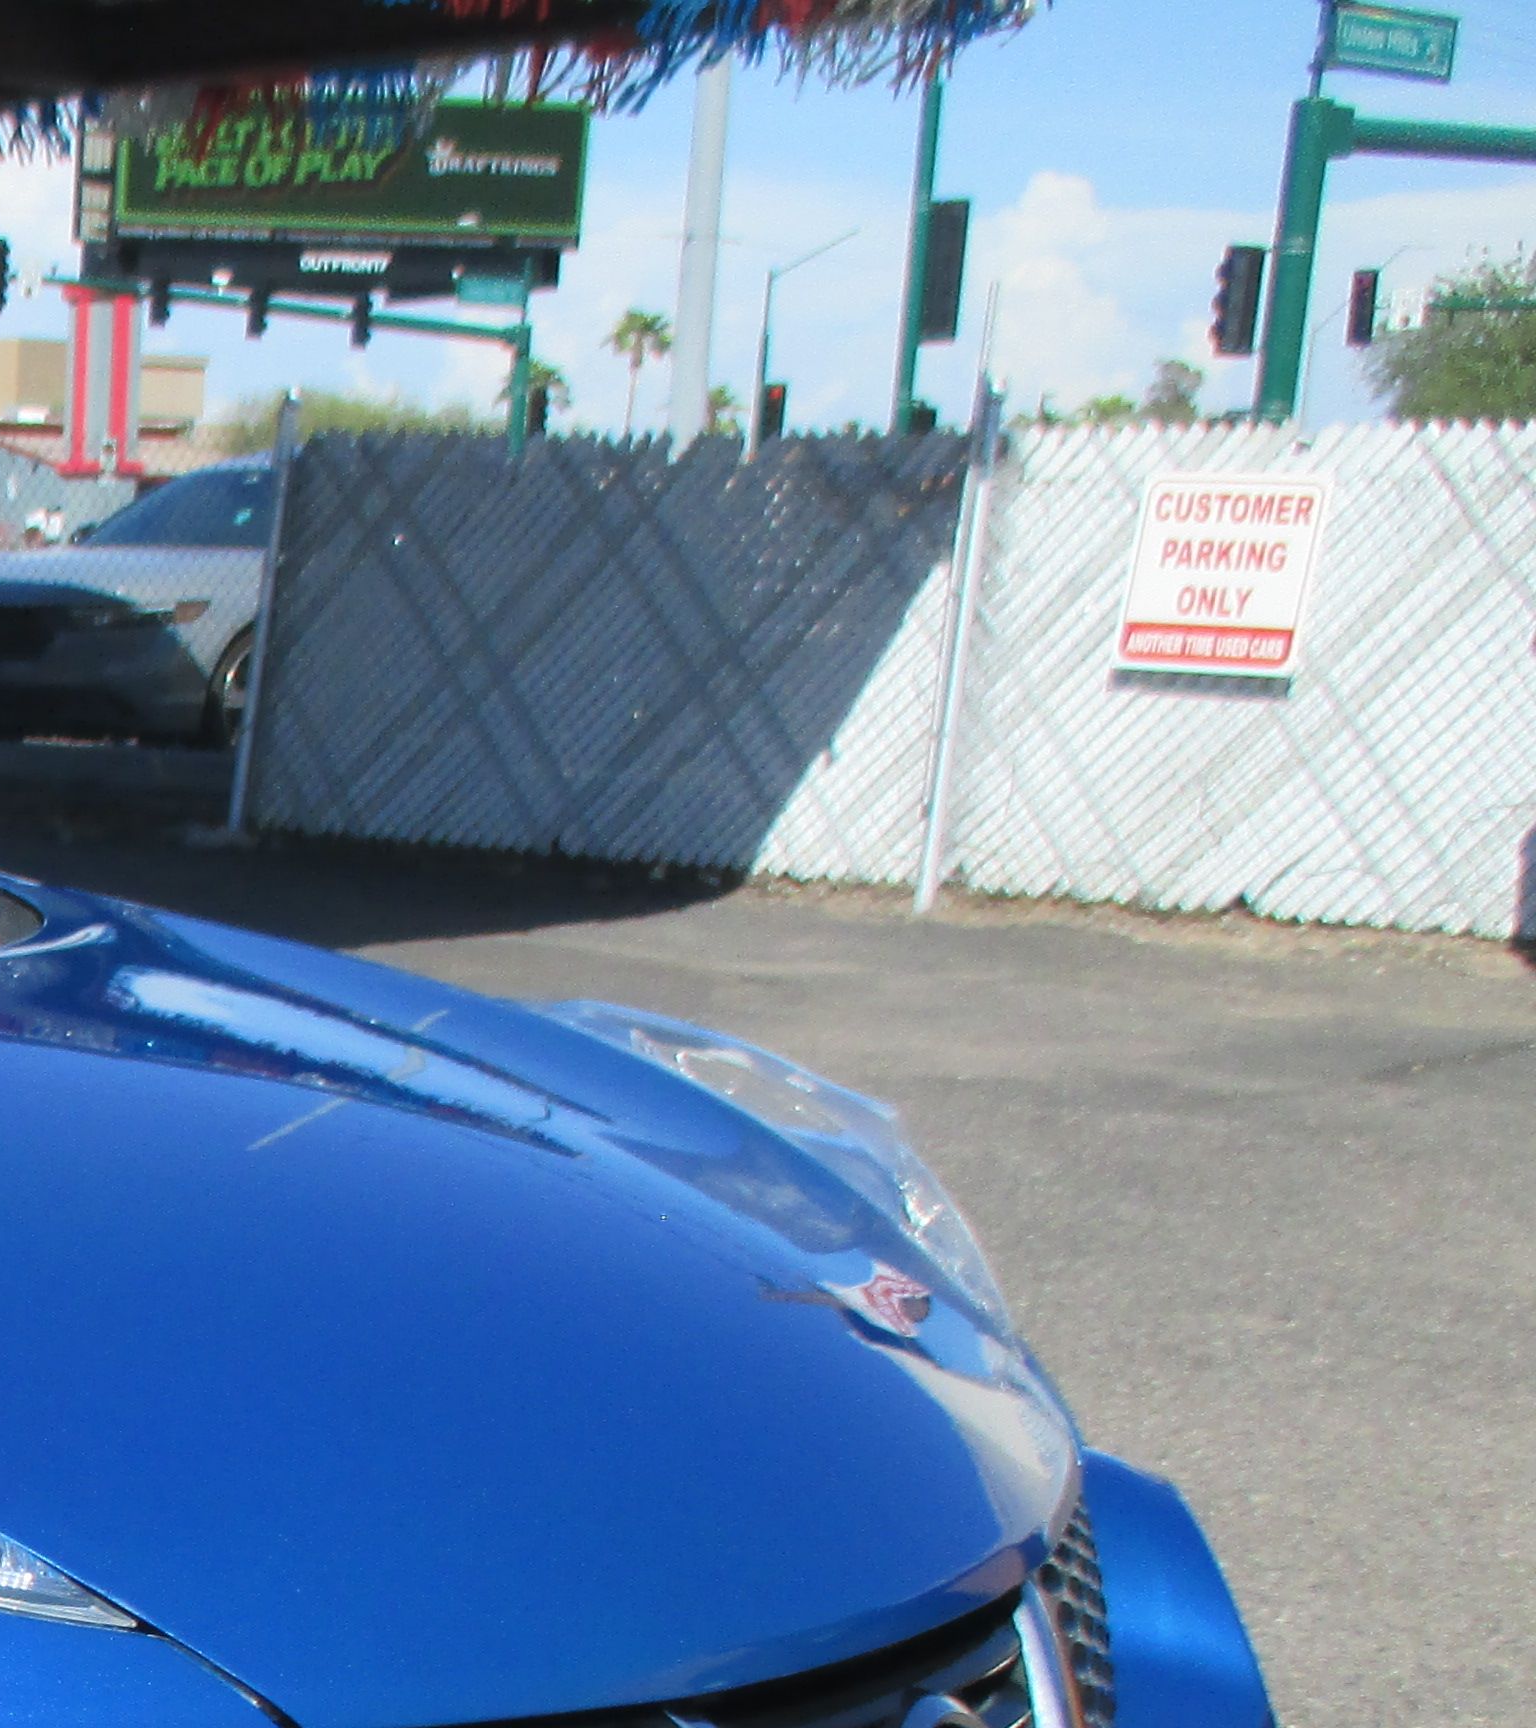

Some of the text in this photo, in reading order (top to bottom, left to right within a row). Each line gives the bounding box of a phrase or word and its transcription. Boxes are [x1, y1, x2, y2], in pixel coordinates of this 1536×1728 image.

[154, 148, 394, 191] PACE OF PLAY
[1155, 492, 1314, 526] CUSTOMER
[1159, 538, 1289, 574] PARKING
[1175, 584, 1254, 618] ONLY
[1126, 632, 1183, 656] ANOTHER
[1185, 635, 1215, 657] TIME
[1215, 636, 1248, 659] USED
